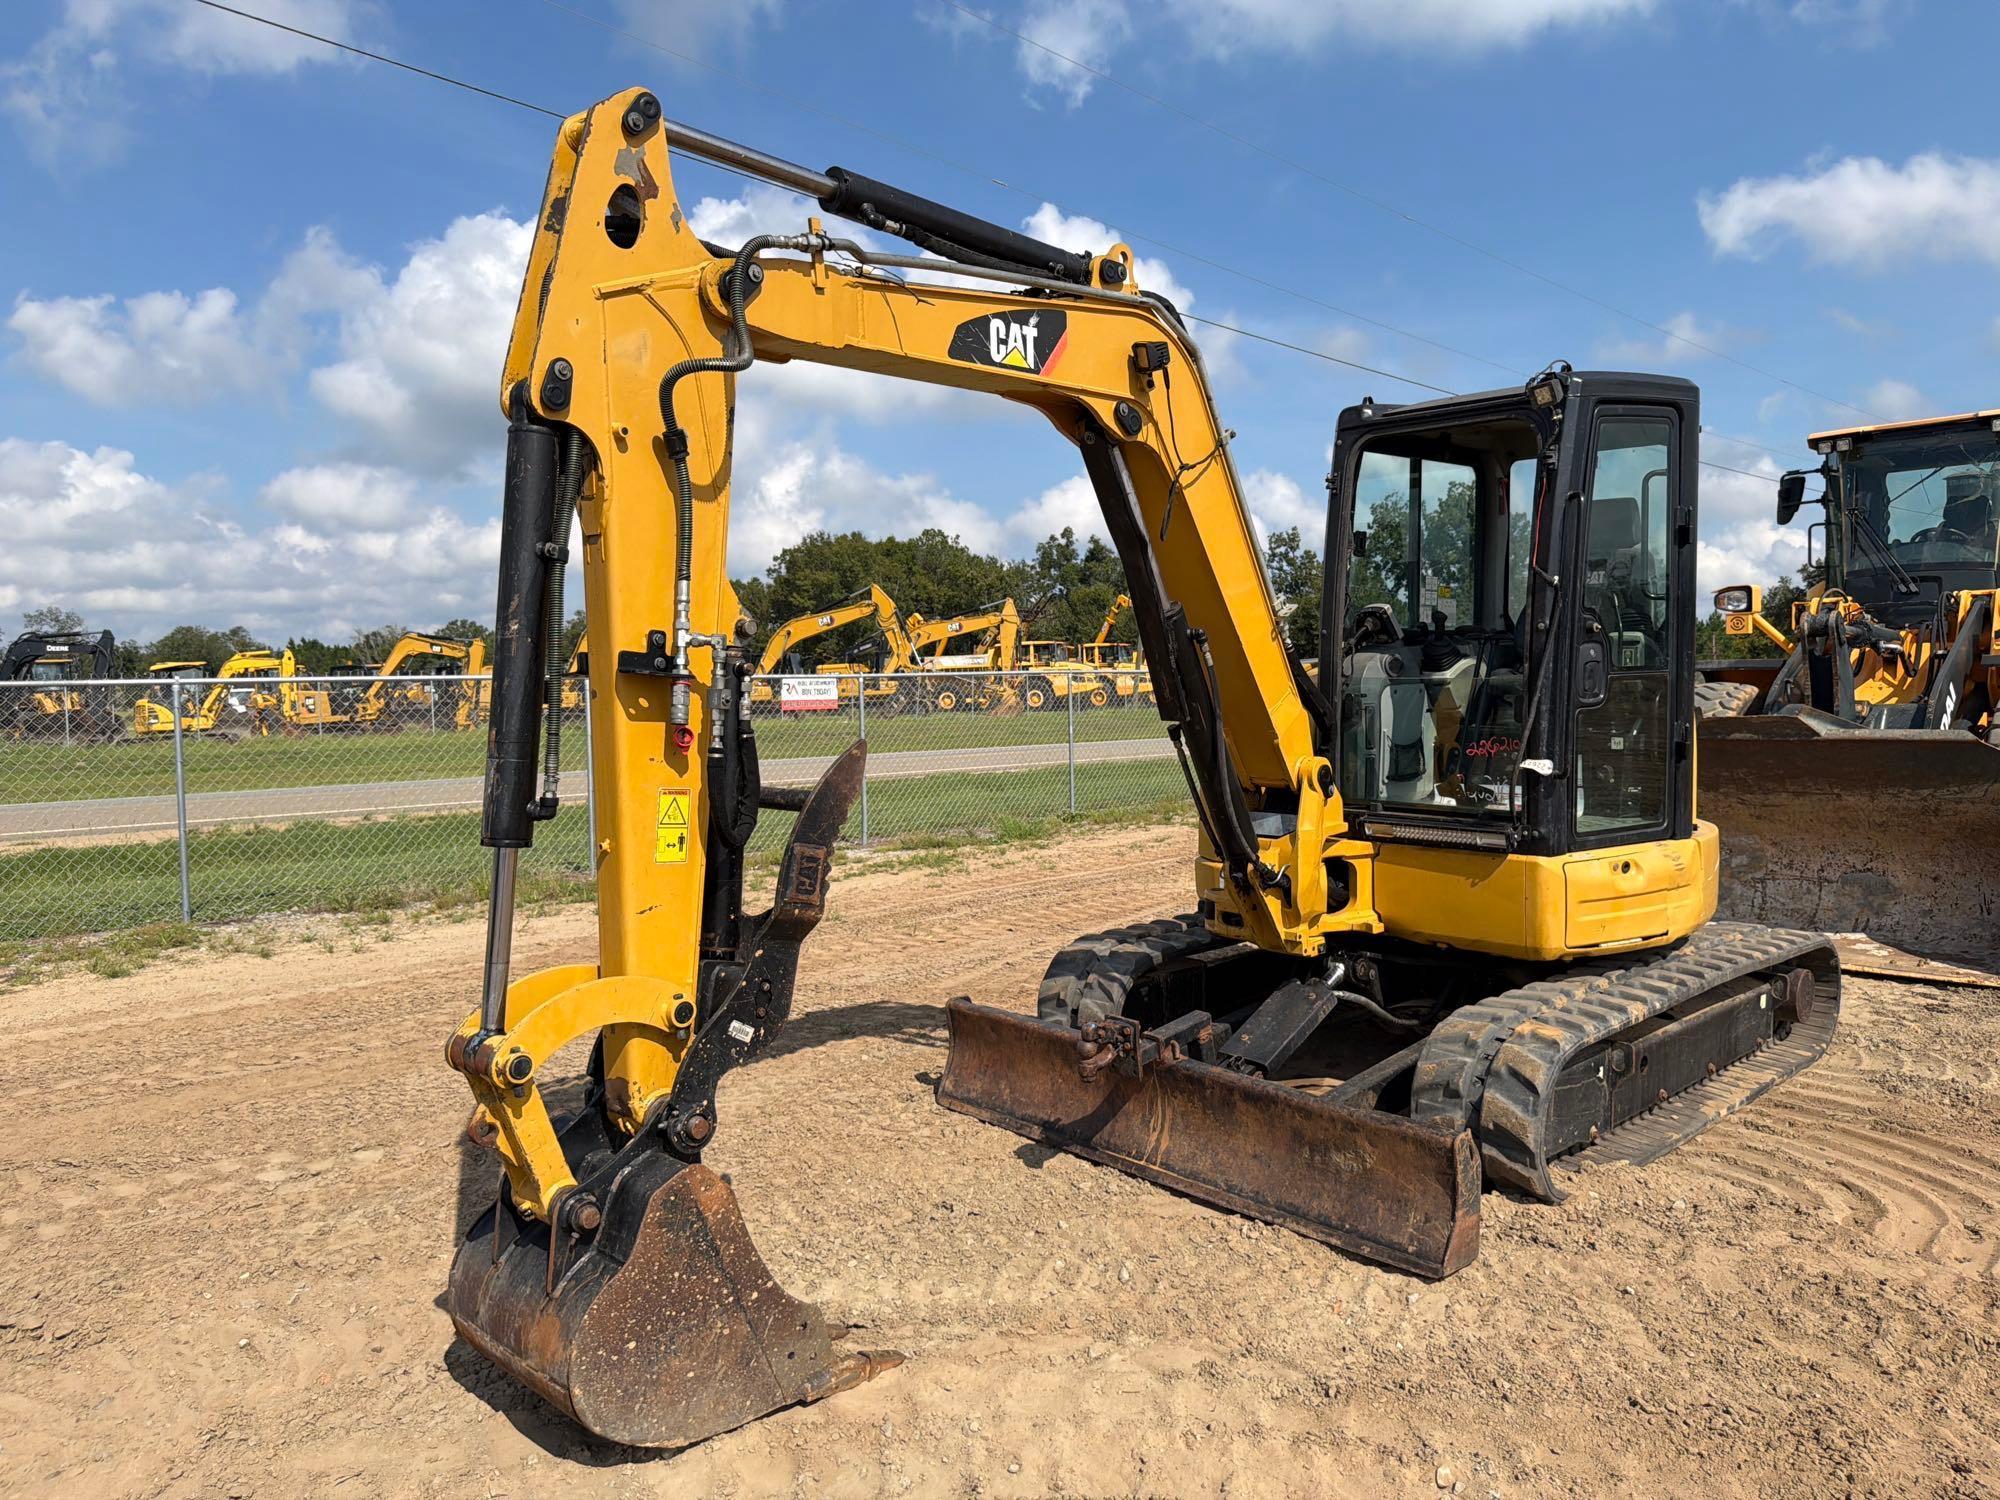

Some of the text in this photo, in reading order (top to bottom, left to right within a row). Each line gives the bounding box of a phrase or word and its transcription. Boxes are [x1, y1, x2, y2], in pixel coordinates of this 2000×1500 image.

[989, 317, 1038, 370] CAT
[818, 615, 832, 627] CAT
[947, 623, 960, 632] CAT
[796, 854, 821, 896] CAT
